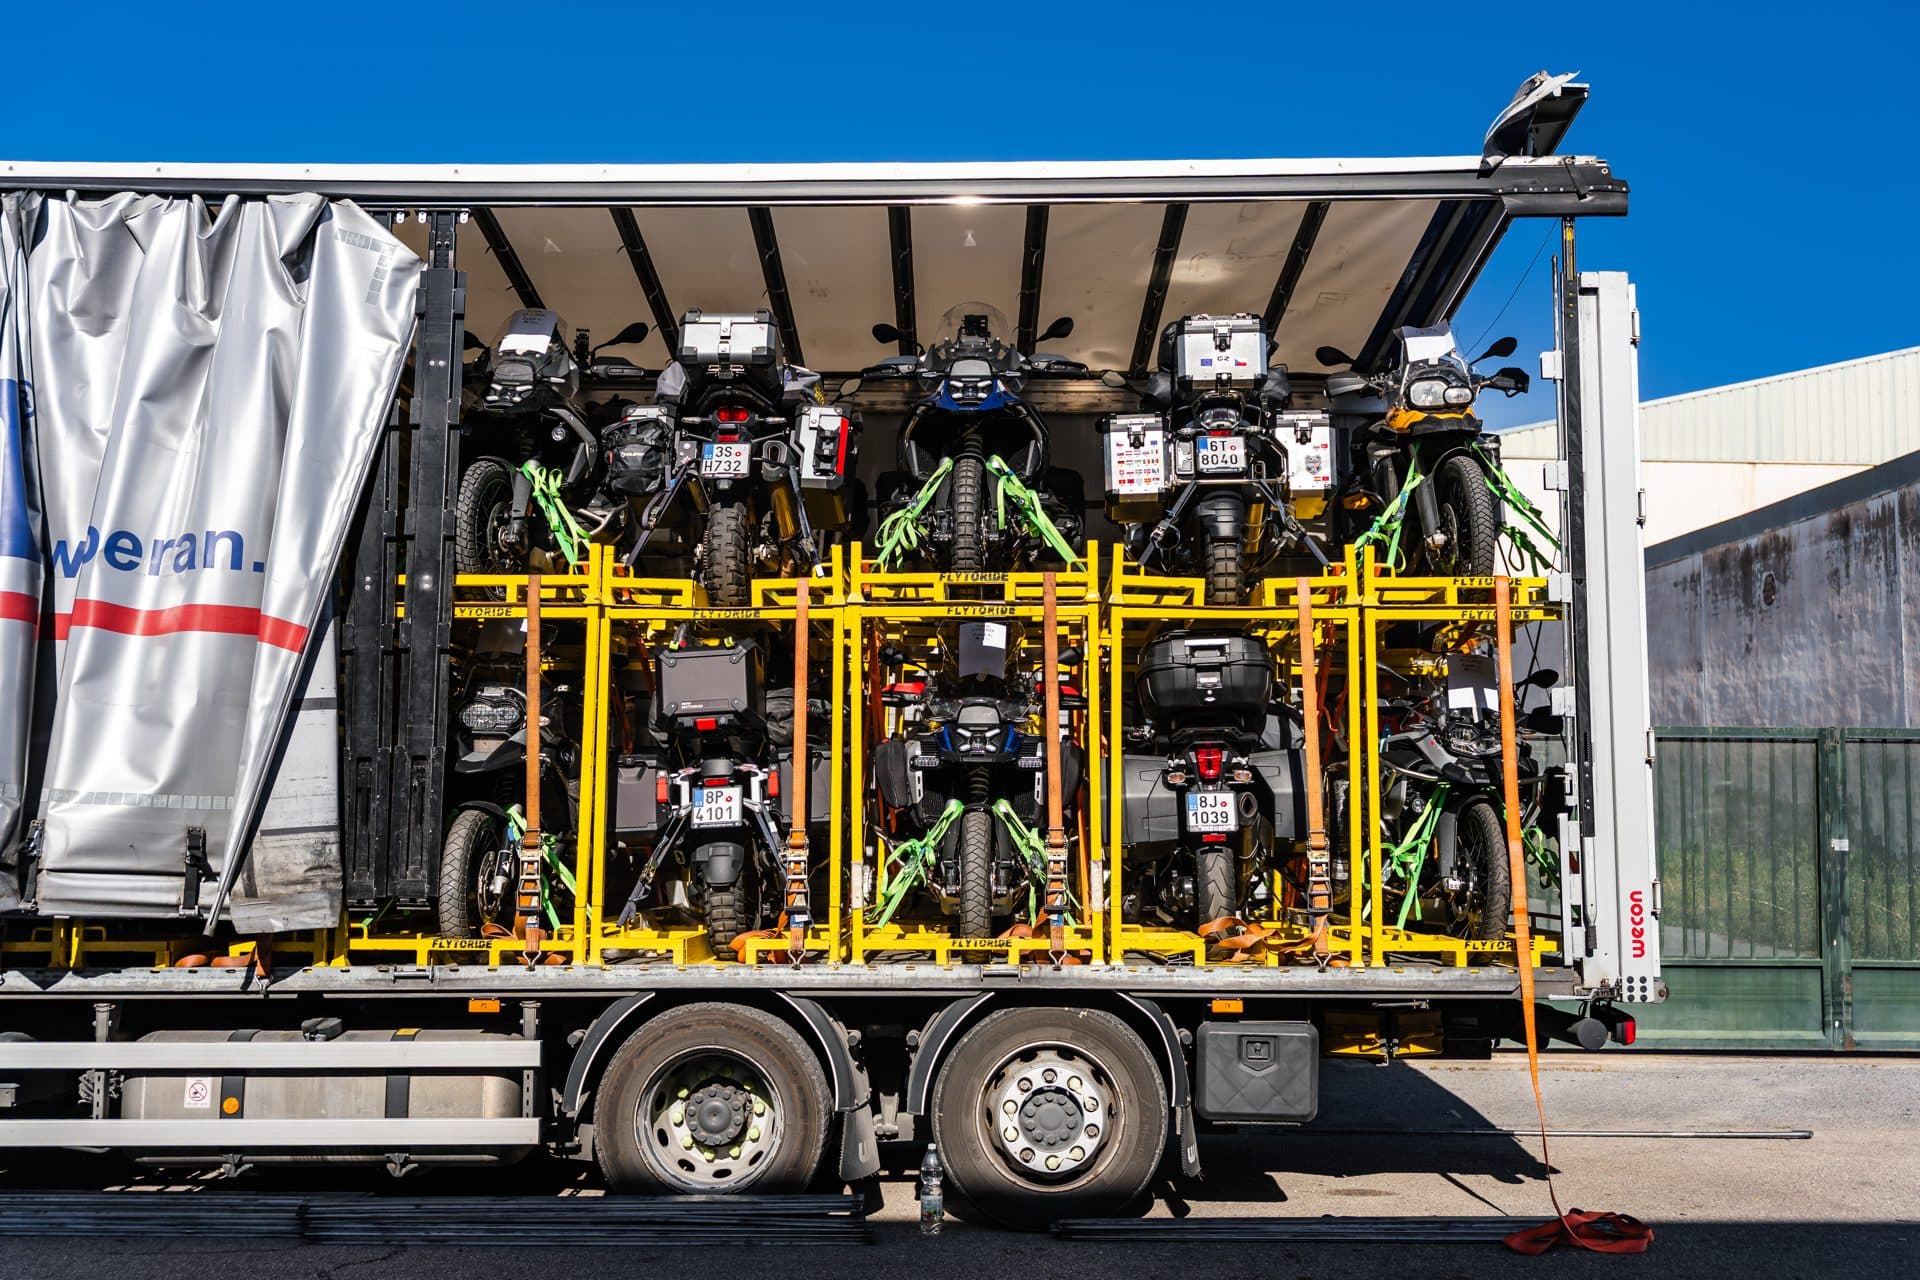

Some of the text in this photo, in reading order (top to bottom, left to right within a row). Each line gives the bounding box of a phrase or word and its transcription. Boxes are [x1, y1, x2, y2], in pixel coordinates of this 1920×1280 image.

[715, 446, 732, 457] 3S
[1210, 440, 1227, 452] 6T
[1201, 454, 1238, 465] 8040
[704, 460, 741, 472] H732
[939, 573, 1008, 581] FLYTORIDE
[947, 607, 1015, 615] FLYTORIDE
[706, 791, 723, 804] 8P
[1199, 795, 1217, 808] 8J
[696, 806, 732, 821] 4101
[1192, 811, 1228, 824] 1039
[1630, 890, 1645, 958] wecon
[432, 940, 492, 949] FLYTORIDE
[951, 939, 1012, 947] FLYTORIDE
